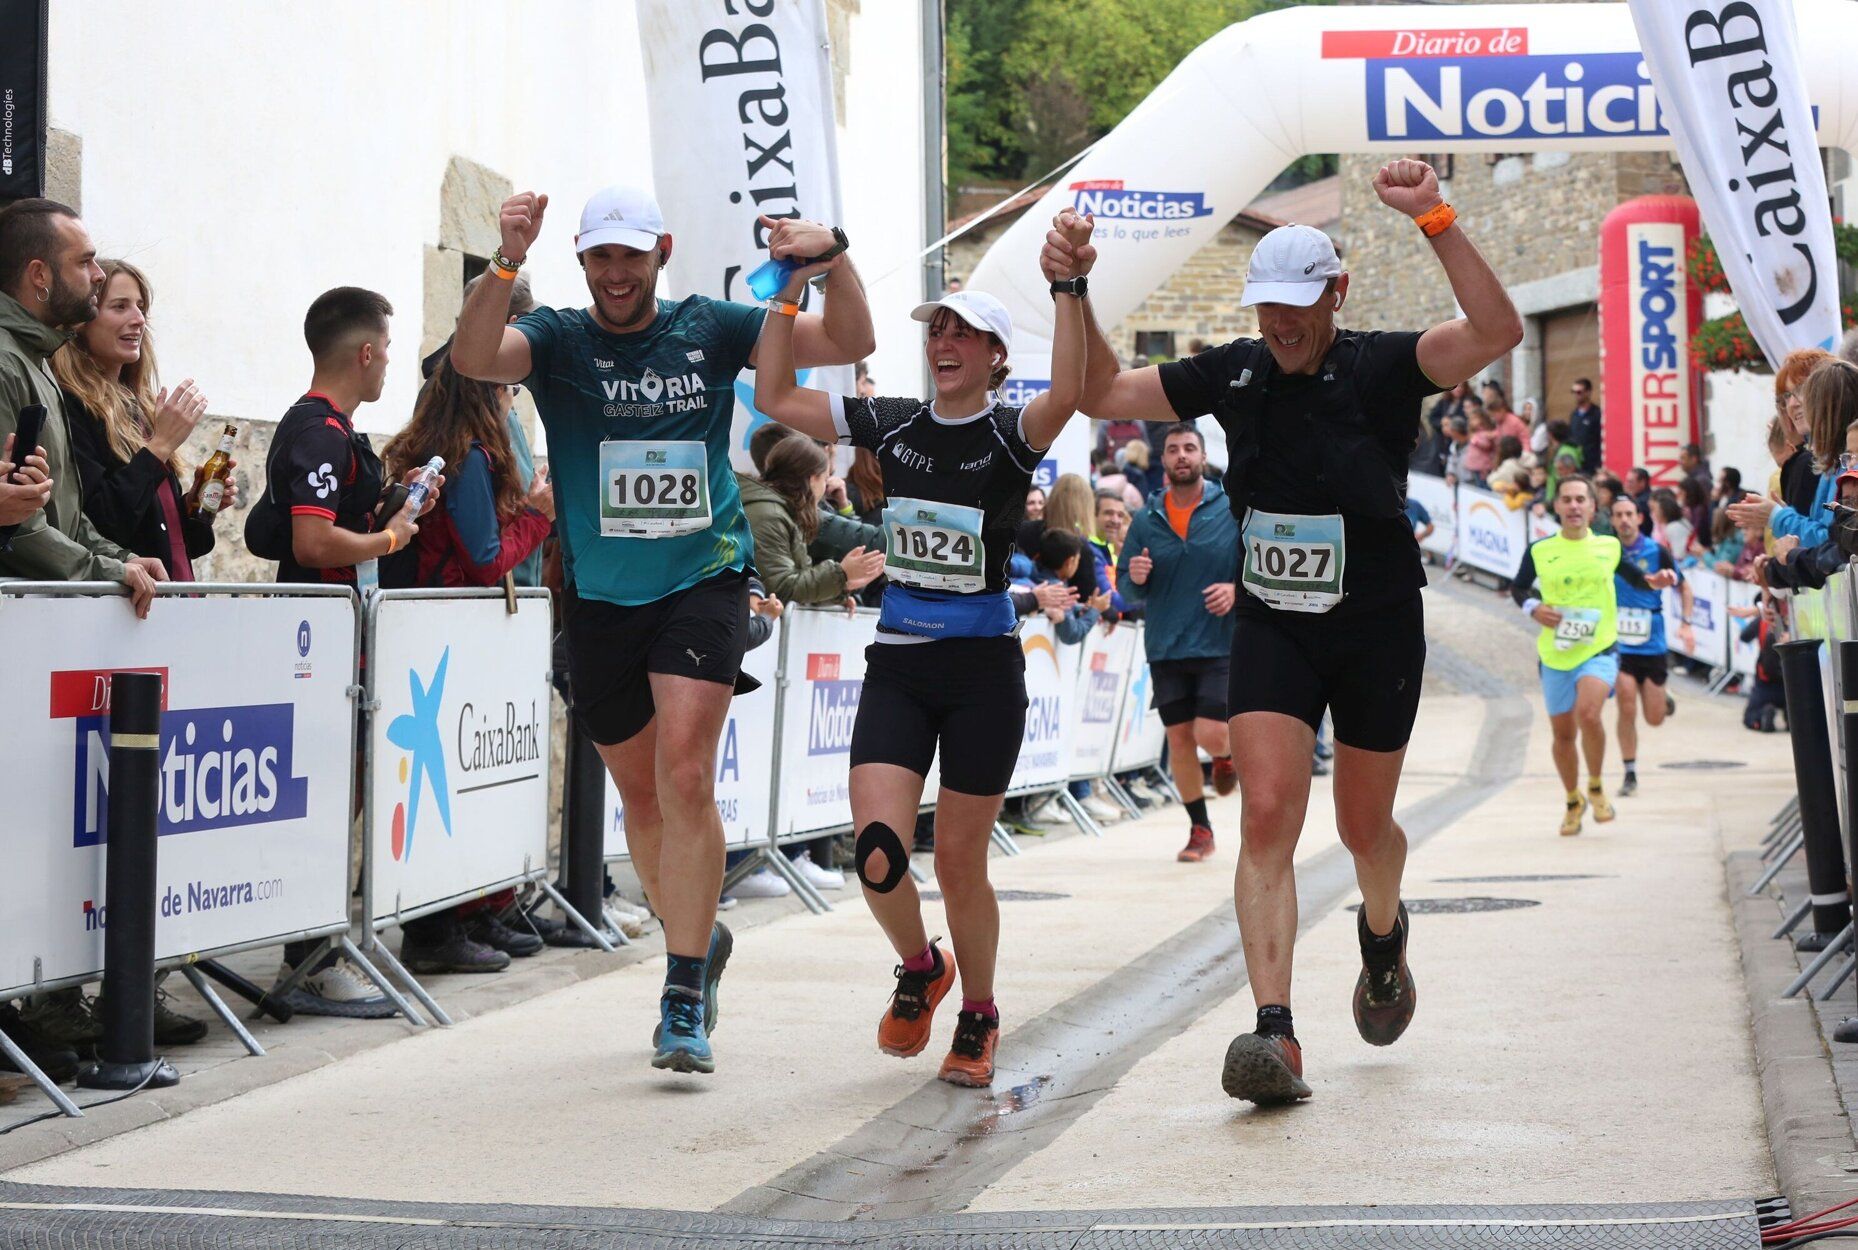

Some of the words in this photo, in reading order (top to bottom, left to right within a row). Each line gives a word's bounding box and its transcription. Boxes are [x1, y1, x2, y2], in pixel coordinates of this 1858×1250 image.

[1391, 31, 1482, 56] Diario
[1488, 29, 1523, 54] de
[1383, 60, 1672, 137] Notici
[3, 88, 15, 175] dBTechnologies
[1076, 191, 1195, 219] Noticias
[1113, 225, 1126, 239] lo
[1132, 229, 1159, 242] que
[1164, 225, 1191, 238] lees
[602, 367, 706, 403] VITORIA
[603, 402, 664, 418] GASTEIZ
[665, 395, 708, 414] TRAIL
[901, 448, 934, 473] GTPE
[614, 473, 698, 505] 1028
[896, 527, 973, 563] 1024
[1253, 542, 1331, 578] 1027
[902, 618, 945, 629] SALOMON
[1563, 621, 1589, 636] 250
[1619, 621, 1641, 633] 115
[458, 698, 540, 773] CaixaBank
[85, 718, 278, 834] Nticias
[161, 886, 182, 918] de
[188, 876, 283, 913] Navarra.com
